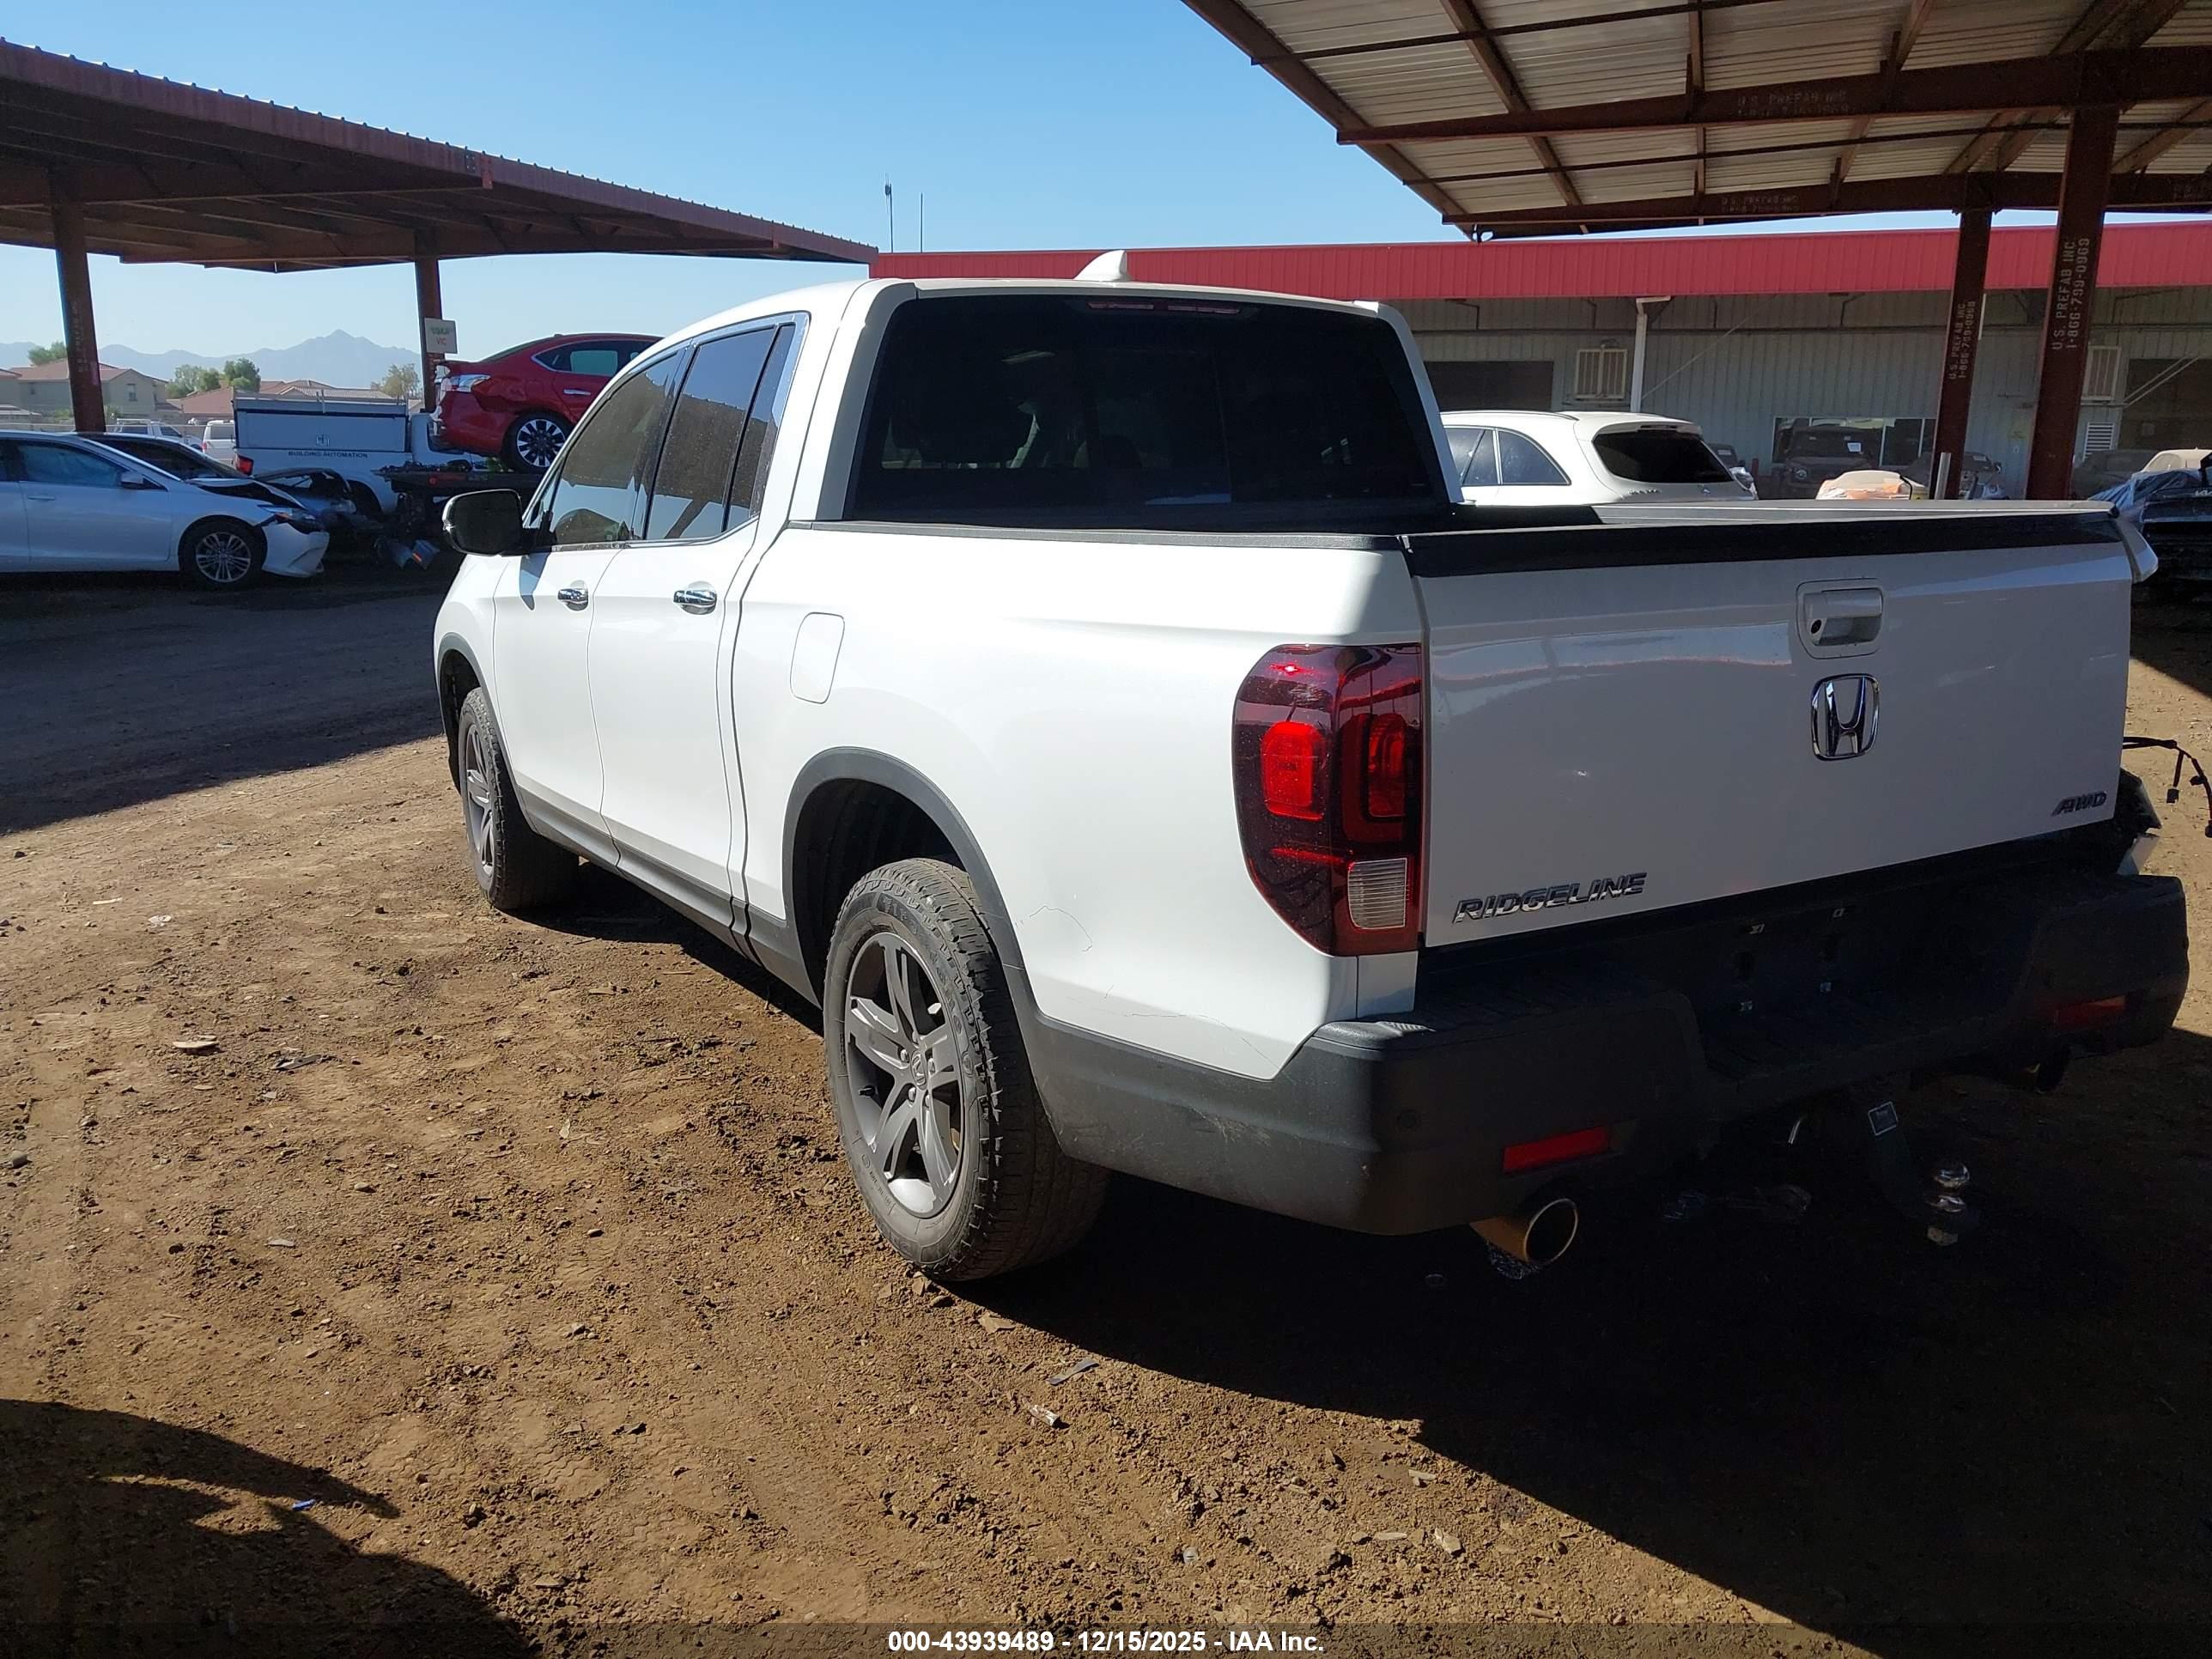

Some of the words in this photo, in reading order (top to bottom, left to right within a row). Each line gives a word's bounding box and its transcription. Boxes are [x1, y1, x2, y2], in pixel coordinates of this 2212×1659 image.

[2055, 269, 2072, 319] PREFAB
[2051, 791, 2107, 817] AWD
[1451, 872, 1647, 924] RIDGELINE
